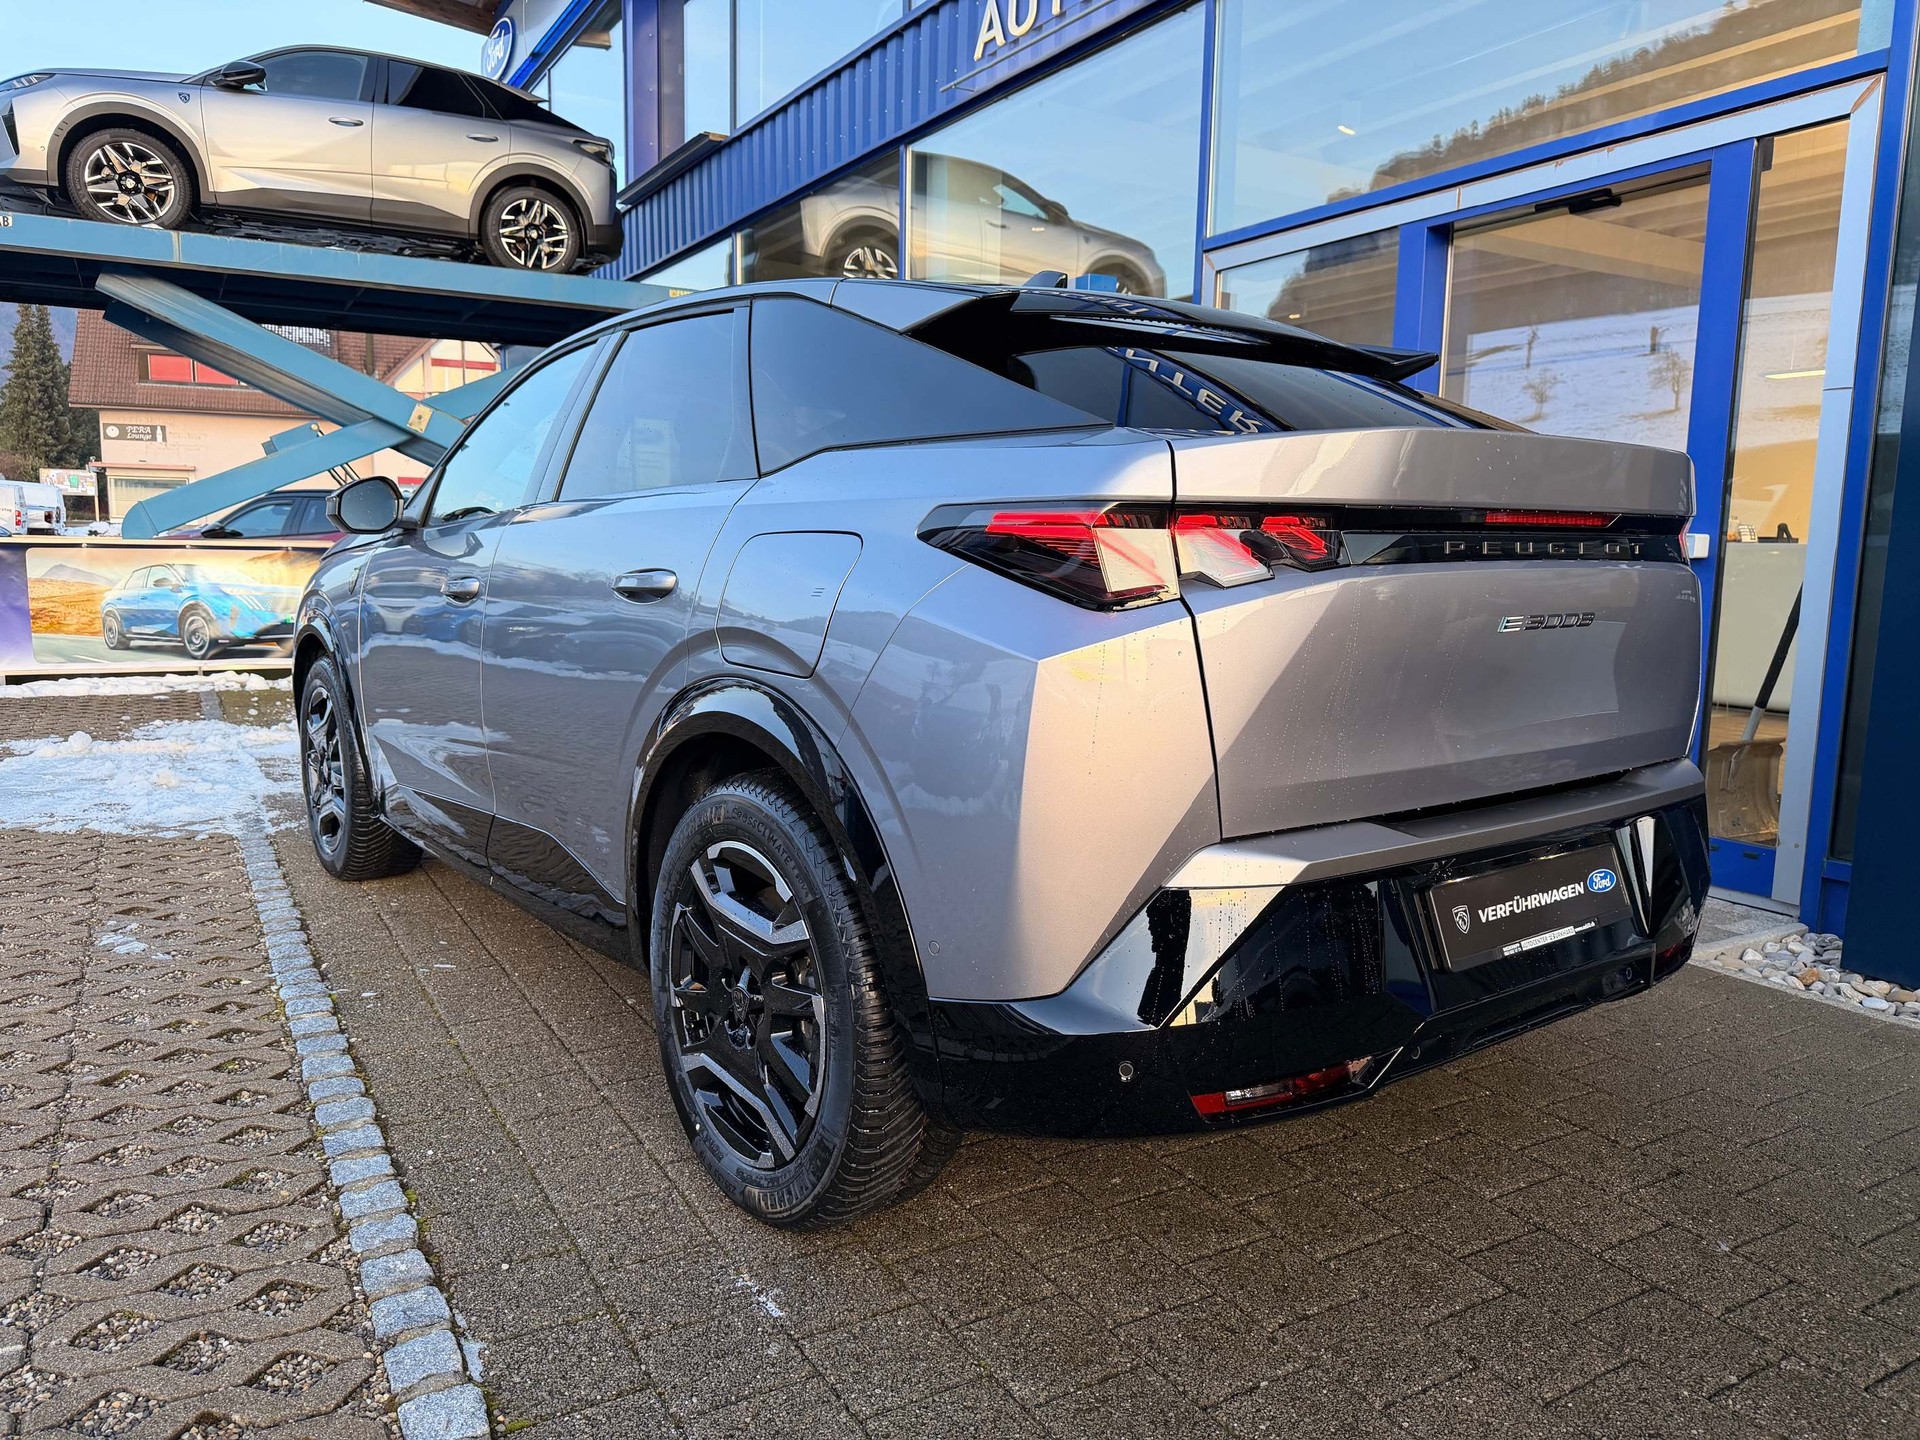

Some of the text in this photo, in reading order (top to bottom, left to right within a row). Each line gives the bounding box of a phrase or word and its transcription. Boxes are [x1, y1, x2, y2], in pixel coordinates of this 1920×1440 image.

[486, 27, 505, 72] Ford
[974, 0, 1061, 62] AU
[1443, 540, 1644, 555] PEUGEOT
[1477, 881, 1585, 923] VERFÜHRWAGEN
